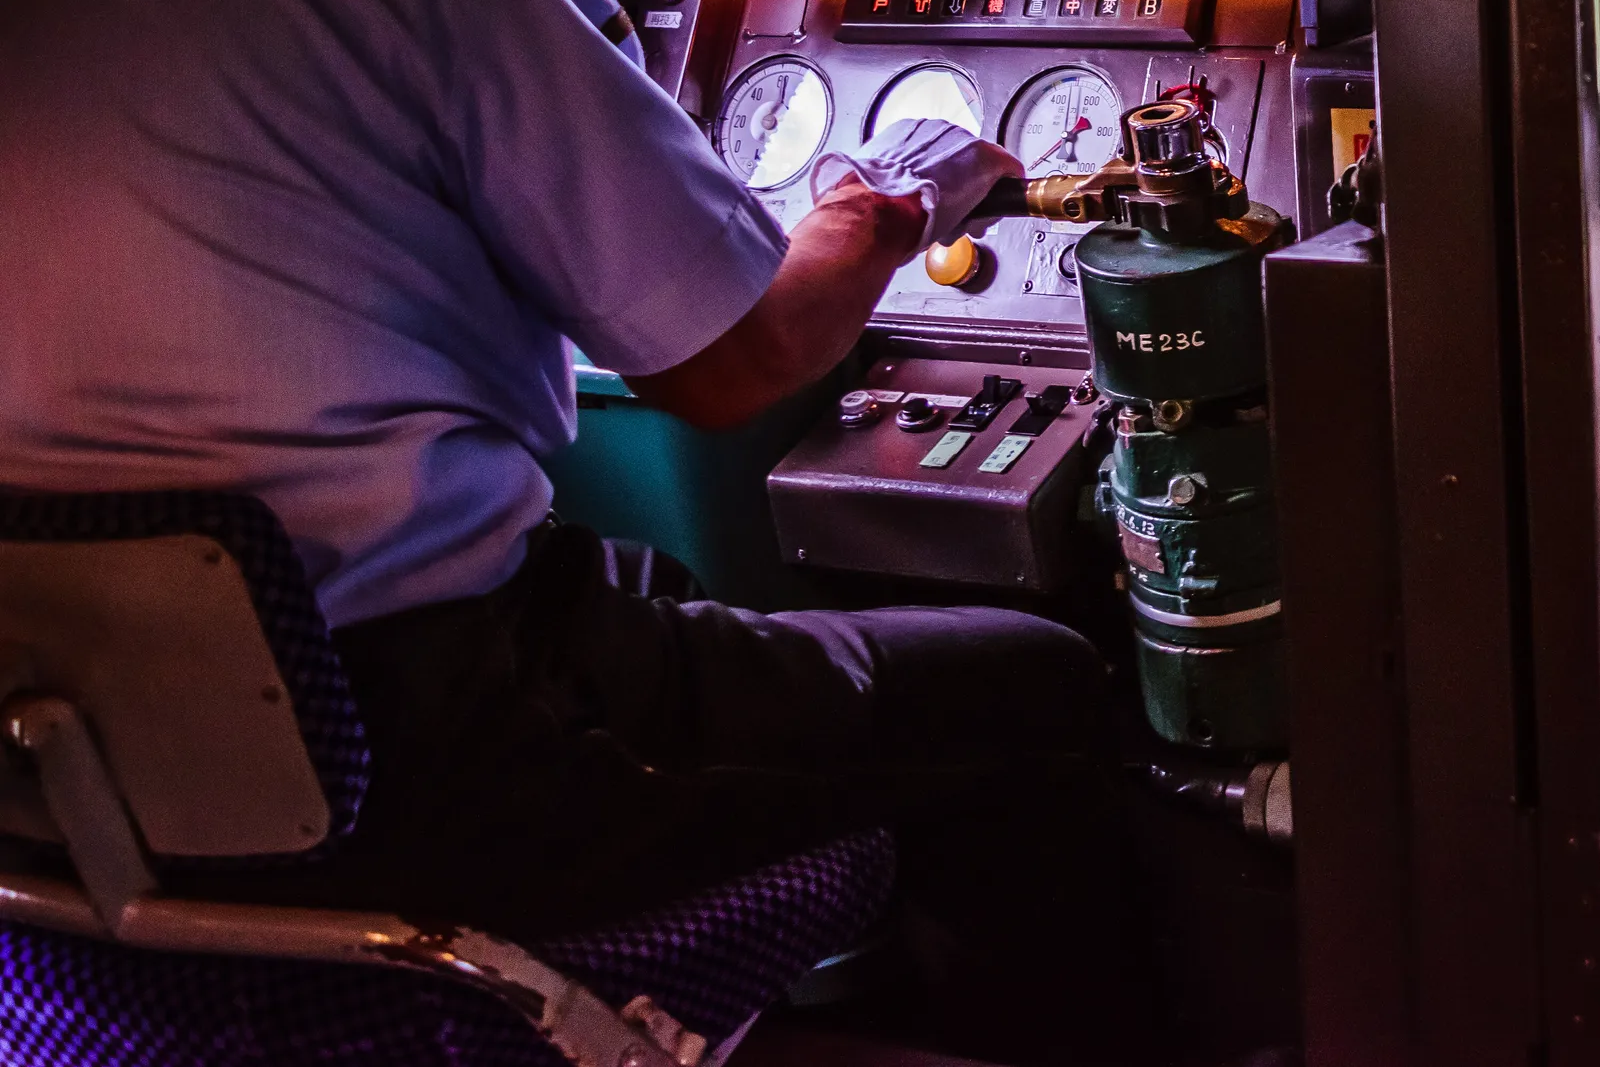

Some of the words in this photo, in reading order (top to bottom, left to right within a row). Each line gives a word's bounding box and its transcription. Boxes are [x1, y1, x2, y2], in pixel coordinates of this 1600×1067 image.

[751, 87, 763, 101] 40
[1050, 94, 1067, 105] 400
[1084, 95, 1100, 106] 600
[733, 114, 746, 128] 20
[1026, 124, 1043, 135] 200
[1096, 126, 1113, 137] 800
[734, 139, 742, 153] 0
[1077, 162, 1095, 173] 1000
[1116, 330, 1206, 353] ME23C
